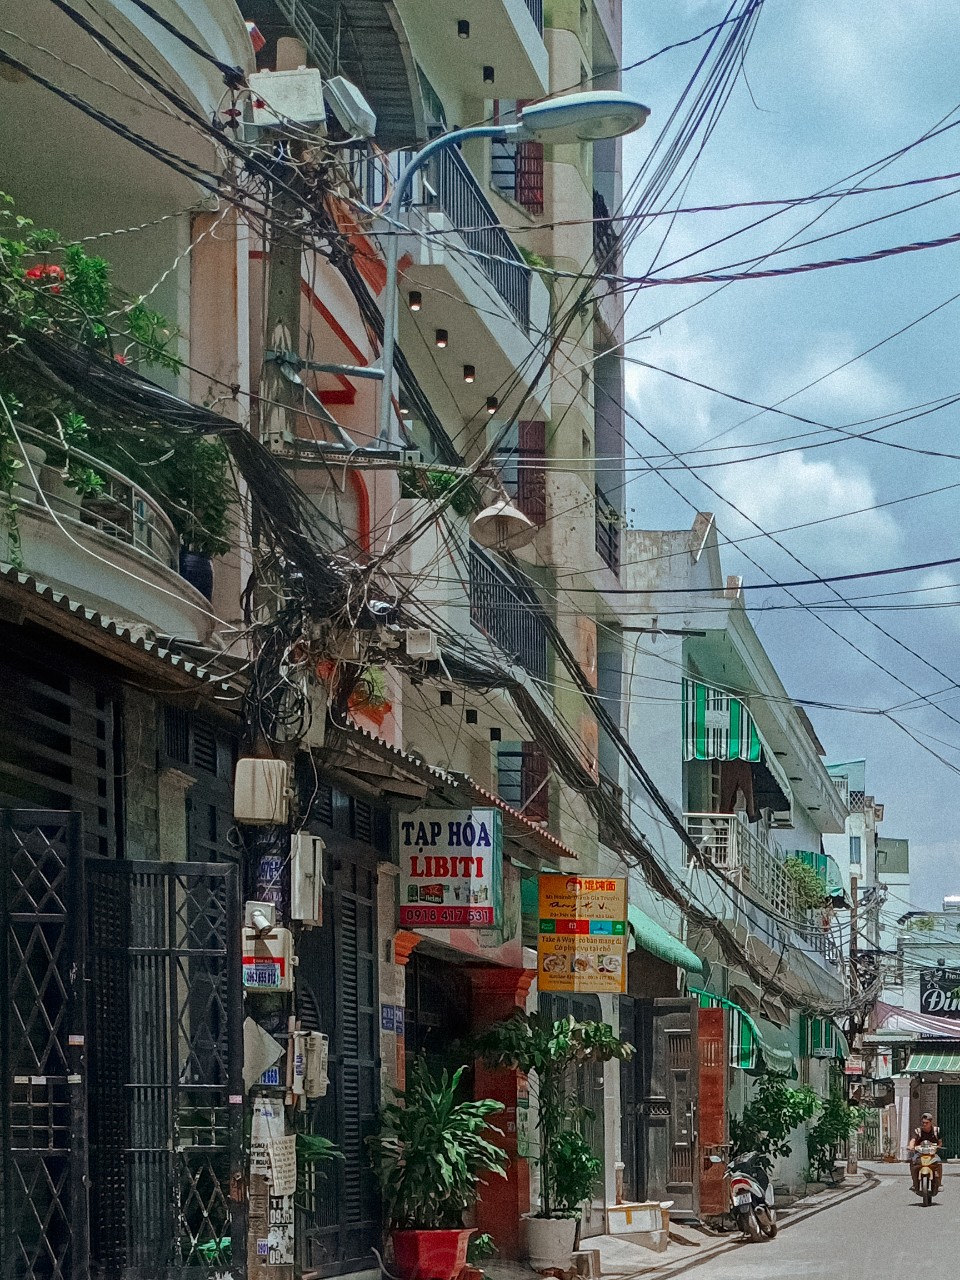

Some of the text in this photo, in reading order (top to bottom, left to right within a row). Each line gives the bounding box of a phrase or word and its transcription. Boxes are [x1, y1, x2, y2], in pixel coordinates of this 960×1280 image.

[402, 814, 492, 853] TẠP HÓA
[410, 856, 484, 878] LIBITI
[406, 908, 489, 922] 0918 417 531
[562, 936, 575, 945] Way
